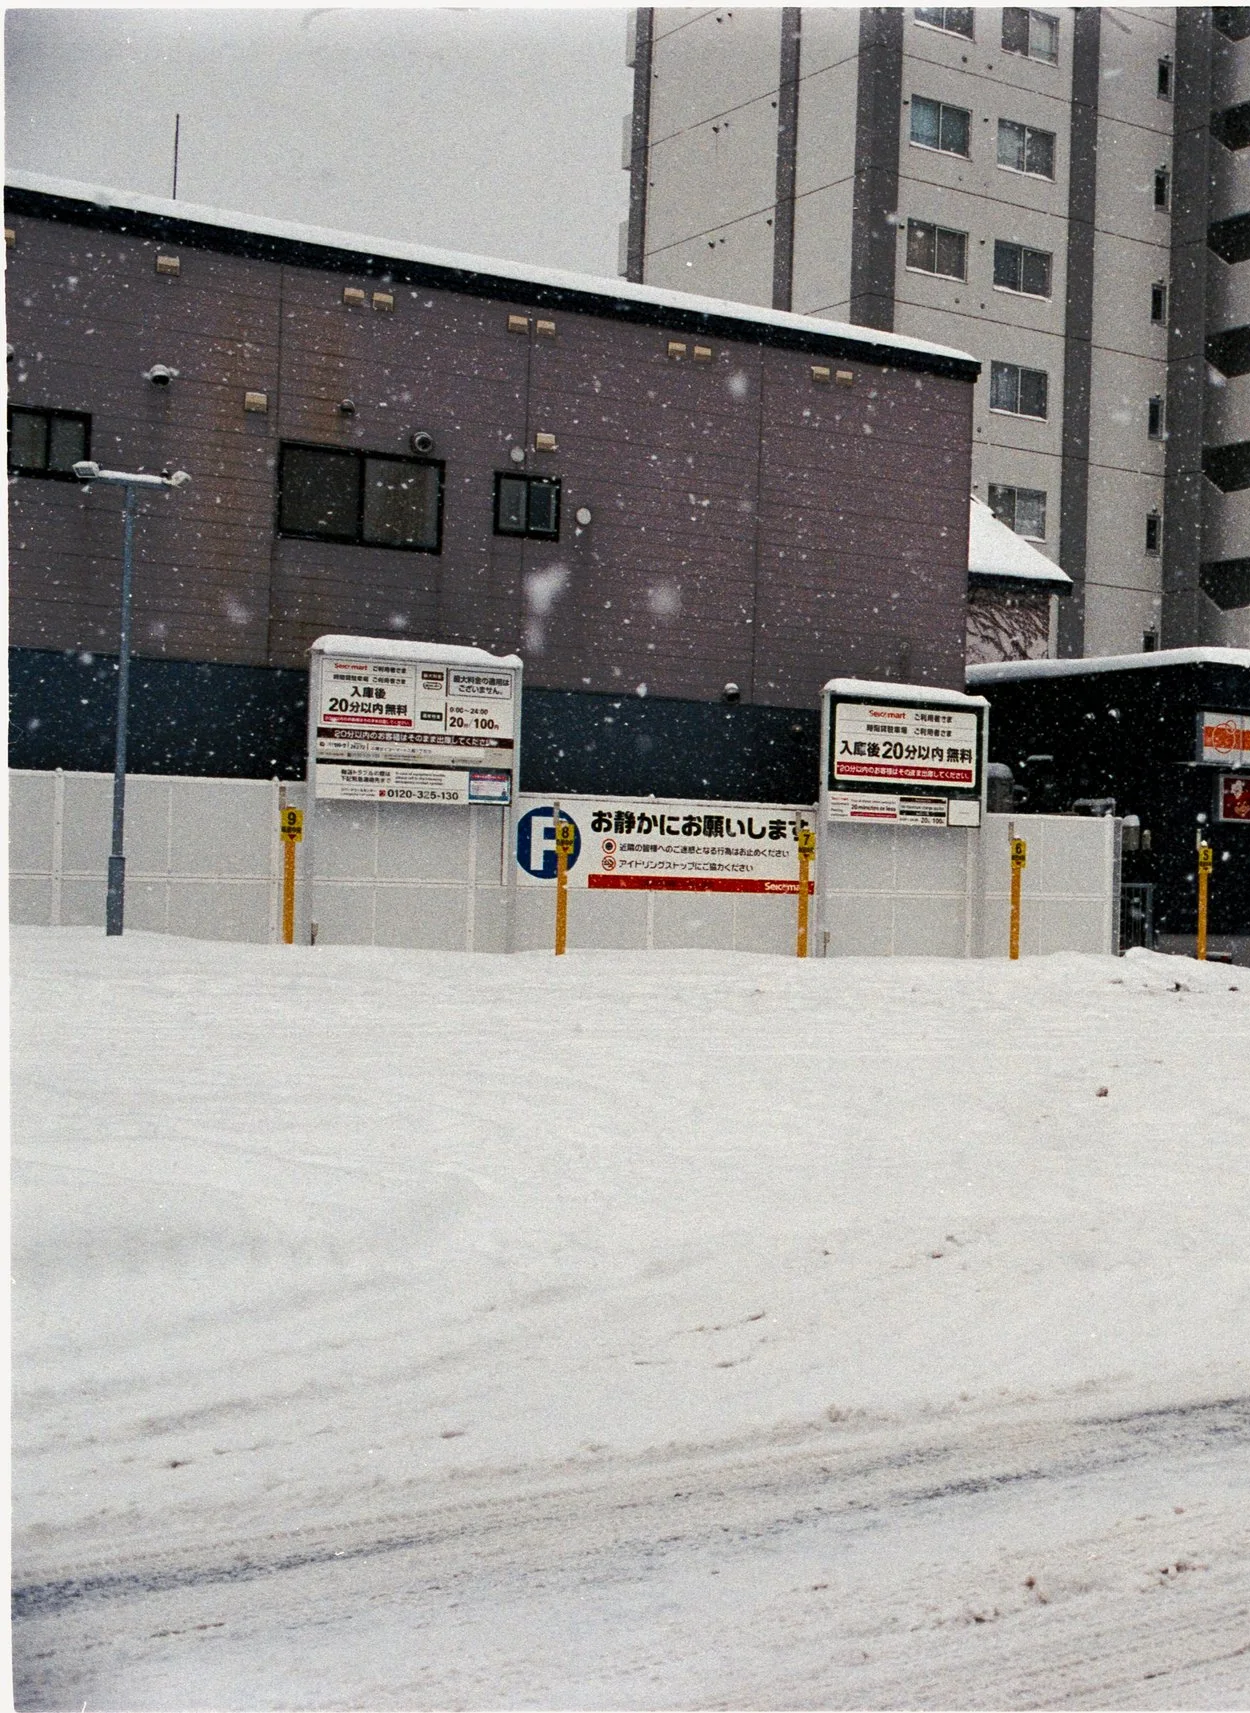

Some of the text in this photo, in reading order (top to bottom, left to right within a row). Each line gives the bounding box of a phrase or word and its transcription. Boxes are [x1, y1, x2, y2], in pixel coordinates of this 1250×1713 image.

[350, 686, 386, 699] 入庫後
[329, 697, 407, 716] 20分以内無料
[334, 729, 494, 747] 20分以内のお客様はそのまま出庫してくださ
[387, 789, 459, 800] 0120-325-130
[288, 811, 296, 825] 9
[561, 826, 569, 838] 8
[591, 810, 808, 841] お静かにお願いします
[803, 834, 811, 845] 7
[764, 882, 800, 892] Seicoma
